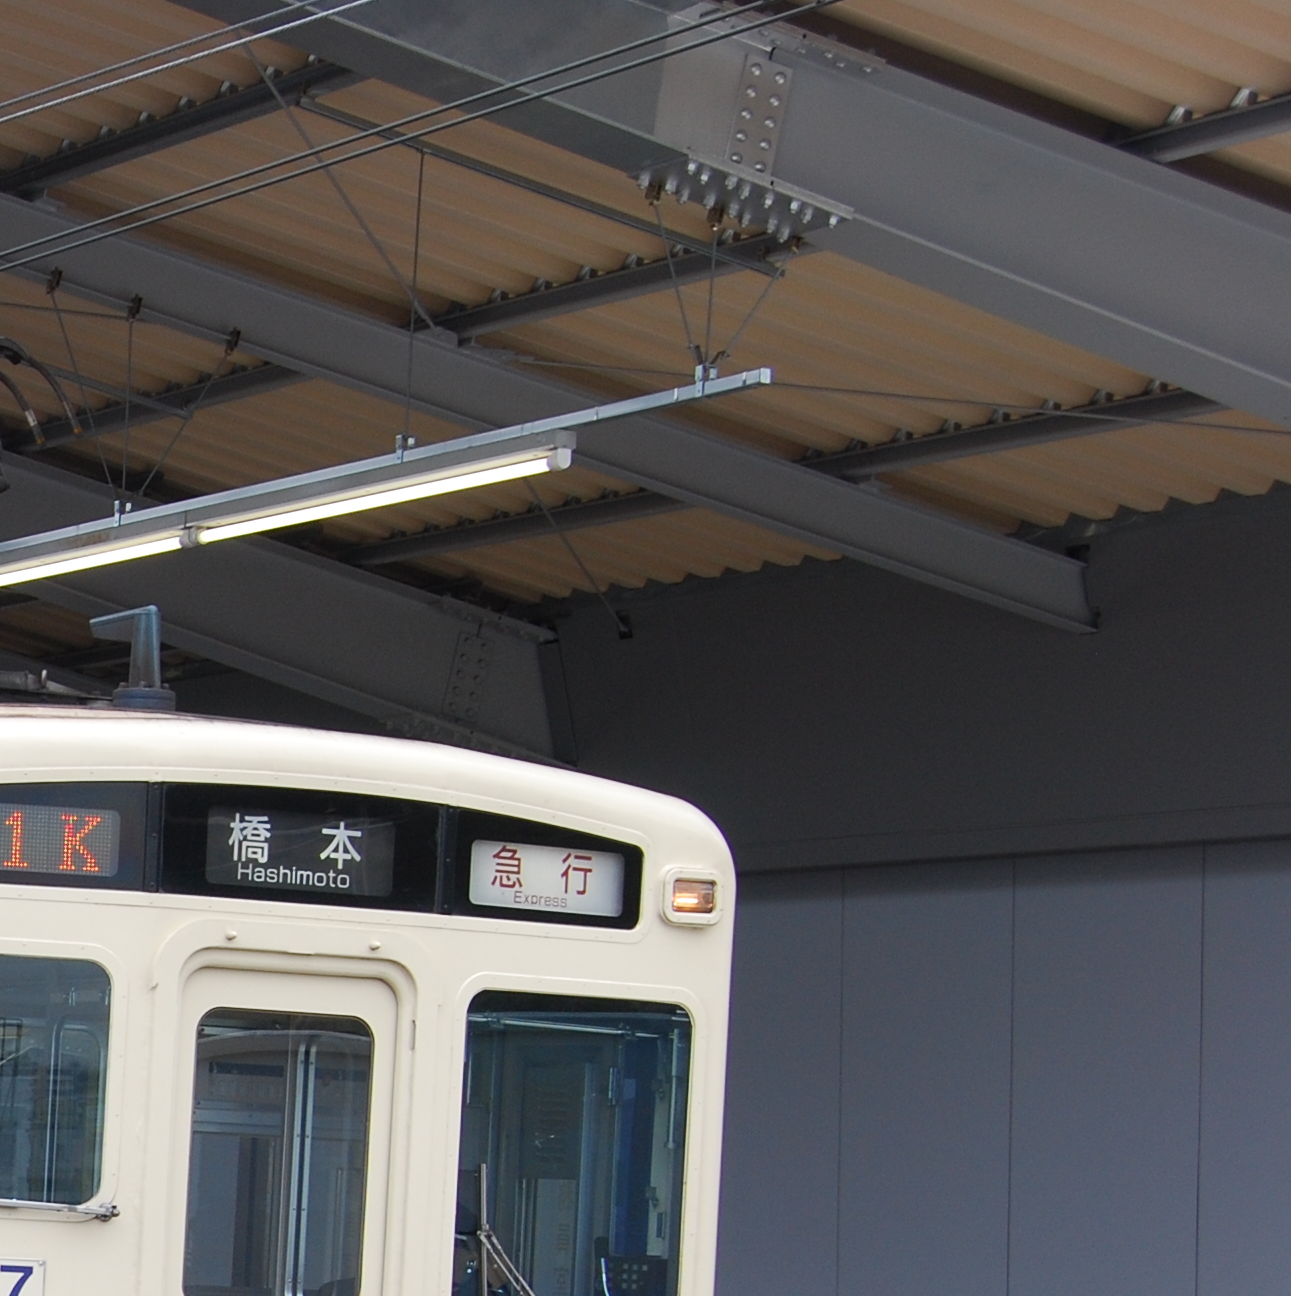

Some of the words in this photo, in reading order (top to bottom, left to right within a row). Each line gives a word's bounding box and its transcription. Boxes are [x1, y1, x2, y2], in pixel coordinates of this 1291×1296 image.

[228, 812, 362, 870] 橋本
[237, 862, 350, 889] Hashimoto
[491, 845, 593, 896] 急行
[513, 890, 568, 908] Express
